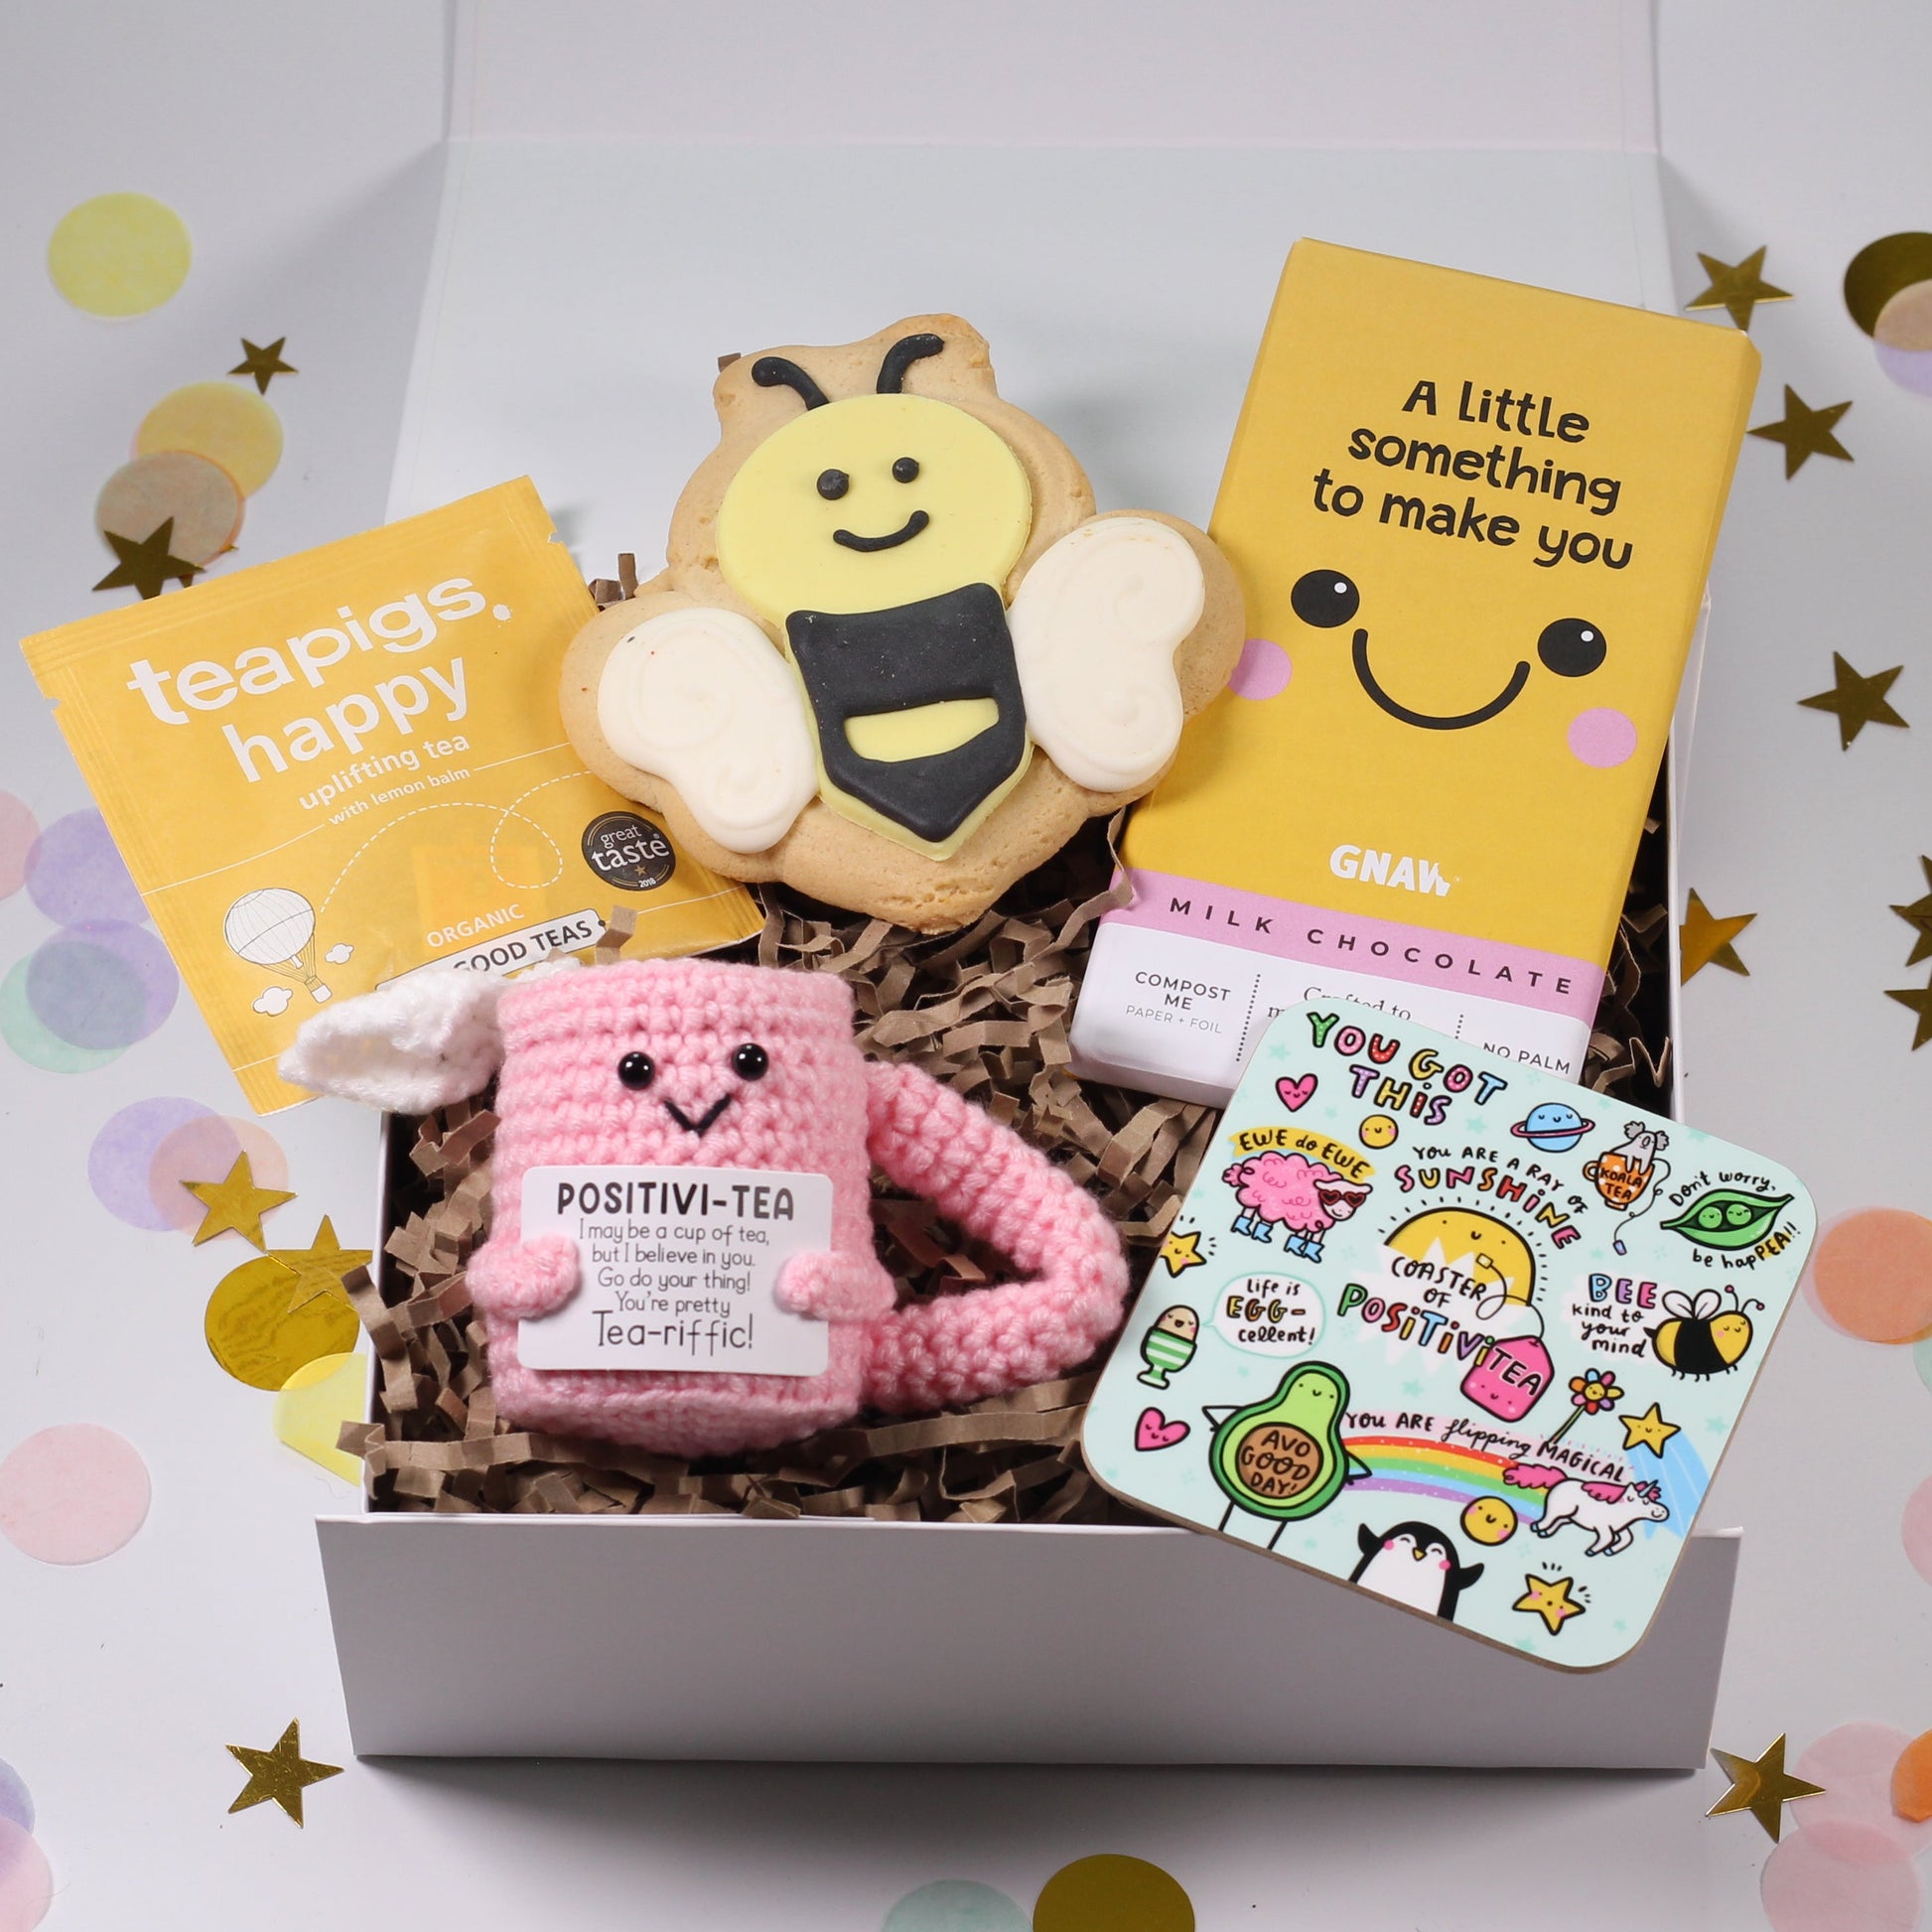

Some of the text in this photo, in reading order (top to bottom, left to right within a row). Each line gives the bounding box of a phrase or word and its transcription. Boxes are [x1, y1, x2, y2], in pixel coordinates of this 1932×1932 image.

[1402, 380, 1589, 443] A little
[1348, 428, 1621, 515] something
[1313, 469, 1633, 569] to make you
[221, 657, 469, 782] happy
[299, 735, 470, 810] uplifting tea
[328, 768, 471, 824] with lemon balm
[601, 825, 641, 849] great
[592, 839, 670, 871] taste
[638, 878, 656, 888] 2018
[1330, 844, 1450, 897] GNAW
[427, 903, 524, 947] ORGANIC
[529, 920, 593, 951] TEAS
[1170, 897, 1571, 994] MILK CHOCOLATE
[1136, 972, 1231, 1001] COMPOST
[1165, 994, 1192, 1010] ME
[1126, 1005, 1173, 1023] PAPER
[1190, 1018, 1222, 1034] FOIL
[1307, 1012, 1508, 1105] YOU GOT
[1518, 1050, 1570, 1074] PALM
[1239, 1129, 1288, 1151] EWE
[1321, 1143, 1370, 1179] EWE
[1461, 1146, 1498, 1163] ARE
[1507, 1158, 1520, 1170] A
[1526, 1164, 1565, 1191] RAY
[1600, 1168, 1642, 1187] KOALA
[1605, 1182, 1632, 1200] TEA
[557, 1181, 793, 1220] POSITIVI-TEA
[579, 1218, 769, 1246] I may be a cup of tea,
[592, 1242, 756, 1270] but I believe in you.
[1693, 1248, 1714, 1267] be
[598, 1267, 751, 1294] Go do your thing!
[1286, 1282, 1301, 1296] is
[1391, 1256, 1487, 1301] COASTER
[1588, 1273, 1658, 1309] BEE
[616, 1291, 731, 1317] You're pretty
[1226, 1296, 1307, 1323] EGG-
[1423, 1288, 1452, 1308] OF
[1572, 1304, 1644, 1322] kind to
[592, 1311, 754, 1356] Tea-riffic!
[1238, 1325, 1315, 1345] cellent!
[1582, 1321, 1630, 1340] your
[1591, 1339, 1647, 1357] mind
[1261, 1430, 1311, 1457] AVO
[1396, 1412, 1435, 1432] ARE
[1441, 1419, 1531, 1459] flipping
[1241, 1446, 1310, 1480] GOOD
